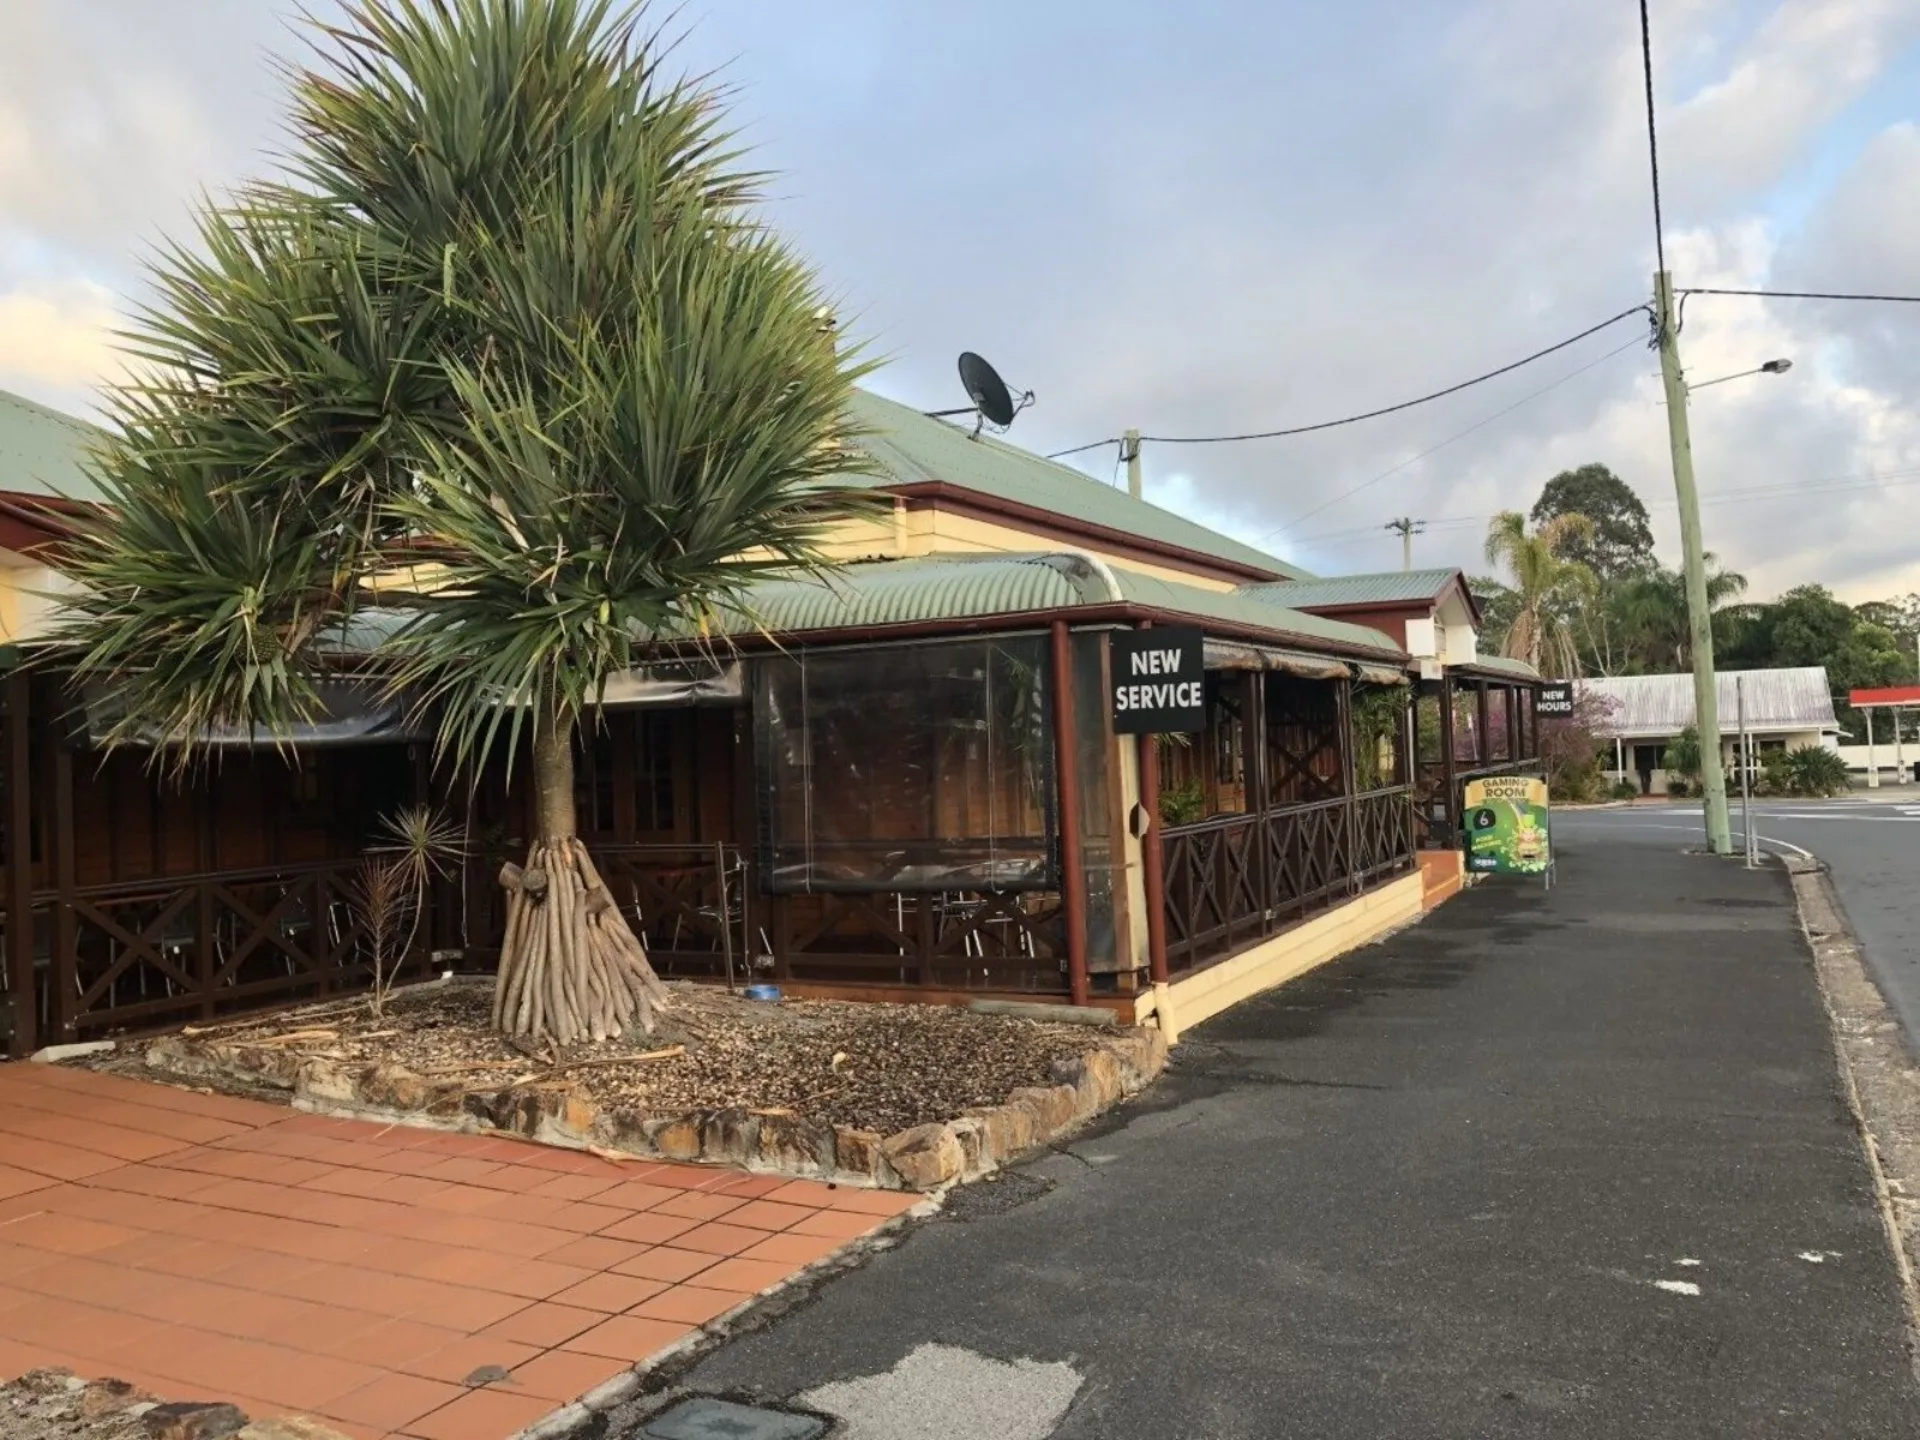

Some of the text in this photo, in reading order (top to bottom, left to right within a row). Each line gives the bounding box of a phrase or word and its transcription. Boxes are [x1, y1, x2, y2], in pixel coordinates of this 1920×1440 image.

[1131, 648, 1181, 675] NEW
[1116, 682, 1202, 710] SERVICE
[1542, 690, 1565, 700] NEW
[1537, 701, 1571, 711] HOURS
[1482, 778, 1529, 787] GAMING
[1485, 787, 1526, 797] ROOM
